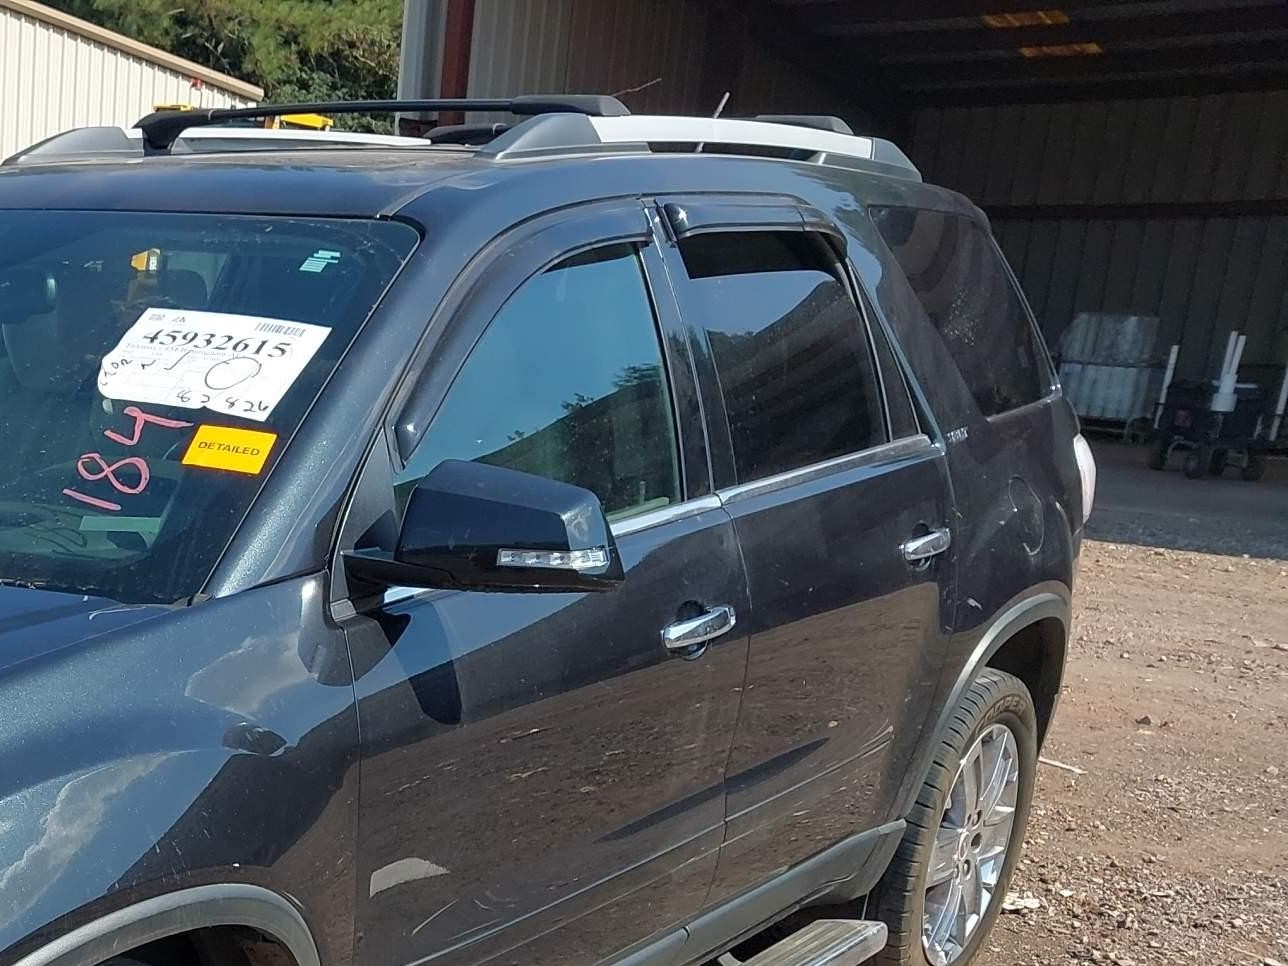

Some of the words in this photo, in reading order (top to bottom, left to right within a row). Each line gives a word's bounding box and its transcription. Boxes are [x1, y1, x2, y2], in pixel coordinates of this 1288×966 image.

[142, 328, 292, 358] 45932615
[62, 406, 195, 511] 184
[197, 440, 261, 457] DETAILED
